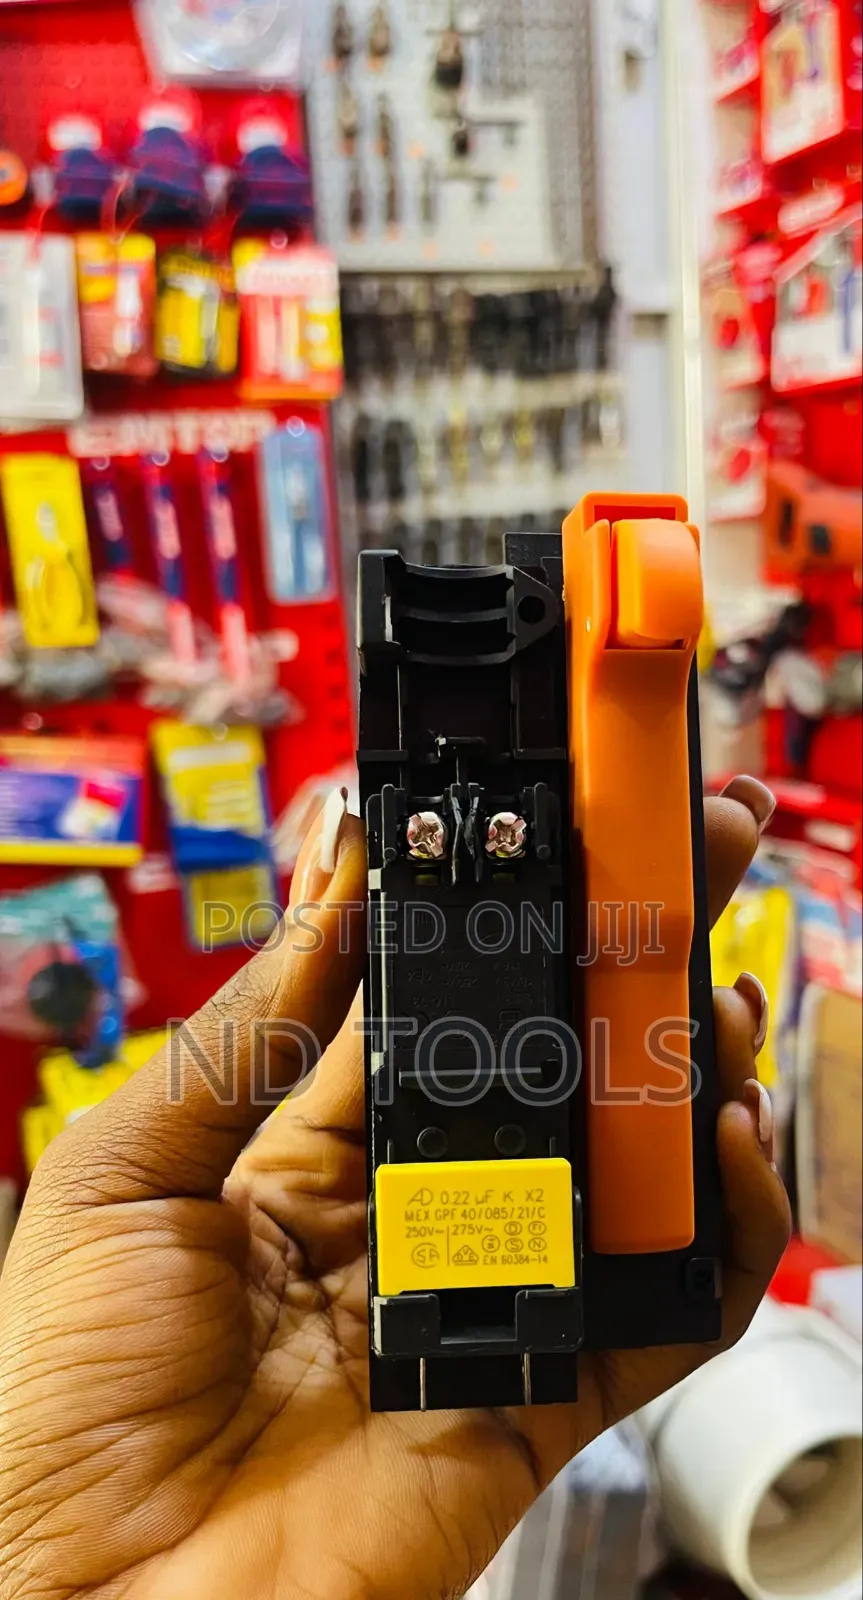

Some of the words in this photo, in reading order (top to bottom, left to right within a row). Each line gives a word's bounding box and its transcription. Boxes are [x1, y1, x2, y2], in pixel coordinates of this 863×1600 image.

[440, 1190, 470, 1205] 0.22
[503, 1190, 514, 1203] K
[525, 1188, 545, 1203] X2
[404, 1208, 430, 1222] MEX
[435, 1208, 456, 1221] GPF
[482, 1254, 498, 1266] EN
